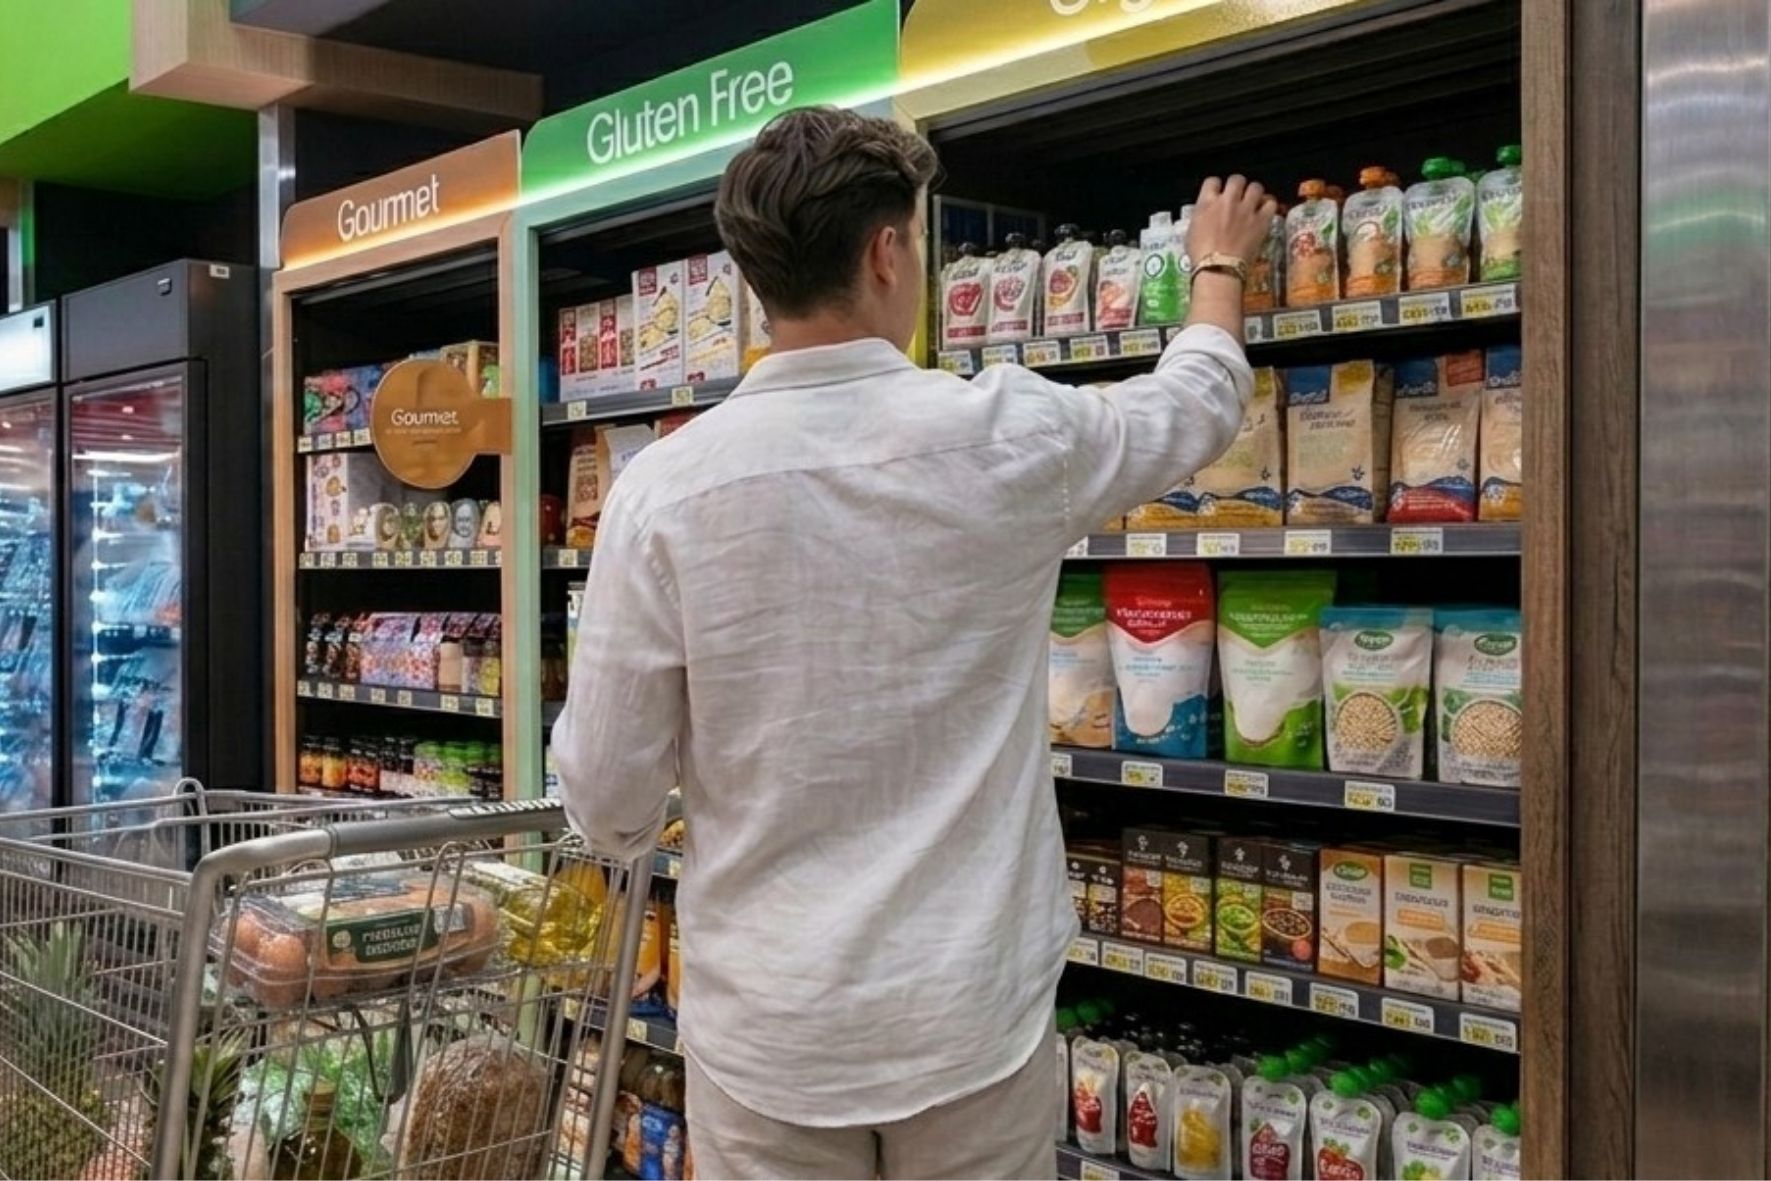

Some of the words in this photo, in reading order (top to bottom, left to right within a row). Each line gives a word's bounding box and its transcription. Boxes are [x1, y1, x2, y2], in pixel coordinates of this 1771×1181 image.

[587, 94, 699, 164] Gluten
[710, 61, 793, 126] Free
[338, 173, 440, 242] Gourmet
